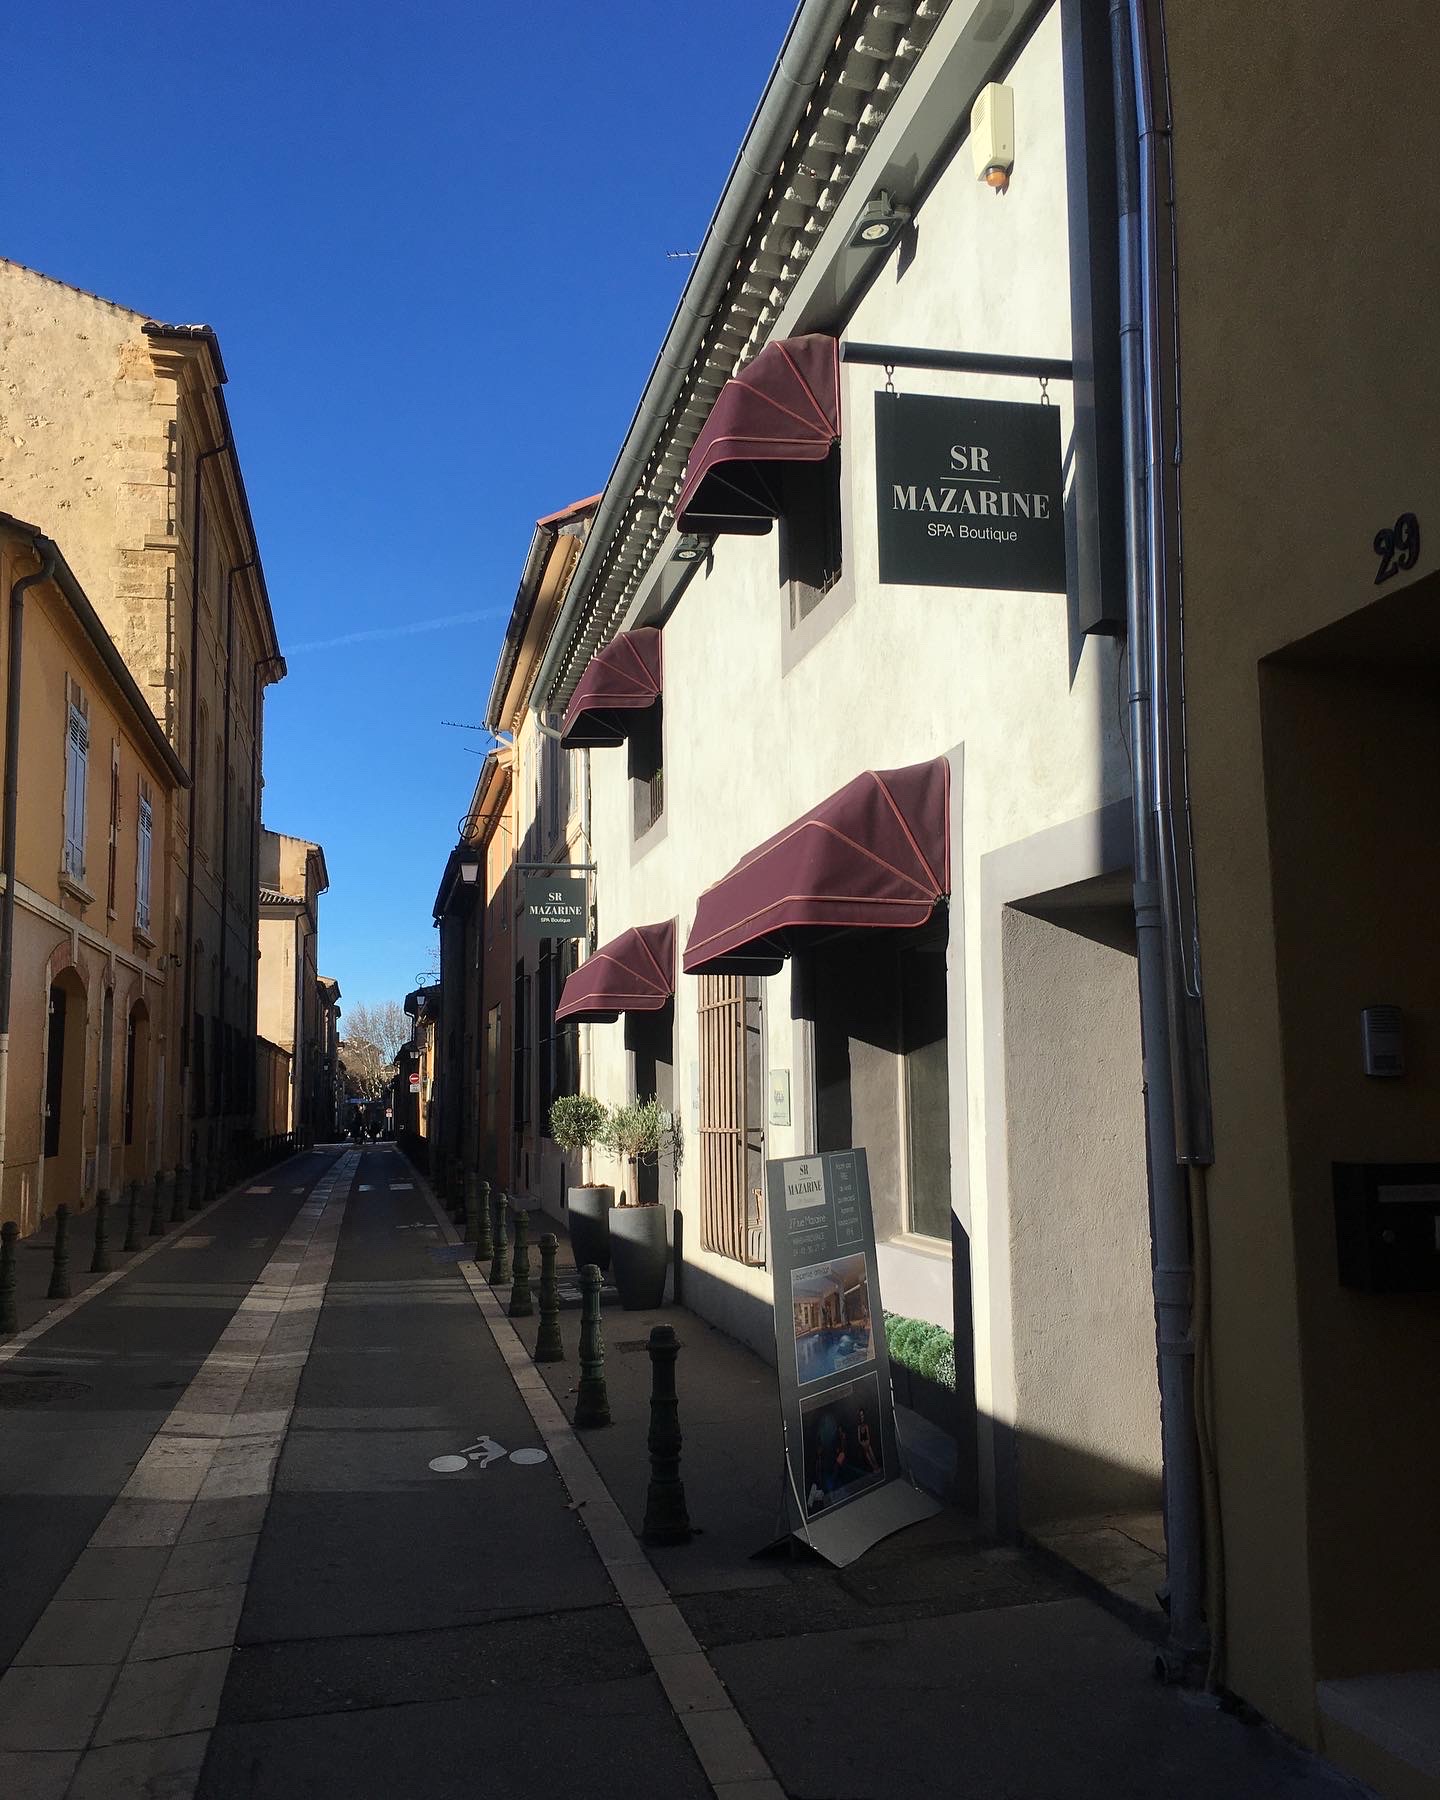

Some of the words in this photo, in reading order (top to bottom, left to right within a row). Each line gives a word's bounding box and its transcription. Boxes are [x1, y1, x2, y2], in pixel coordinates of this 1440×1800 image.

[950, 445, 990, 472] SR
[892, 484, 1050, 519] MAZARINE
[927, 523, 955, 538] SPA
[959, 525, 1018, 543] Boutique
[1373, 511, 1420, 585] 29
[548, 892, 562, 901] SR
[529, 905, 582, 915] MAZARINE
[799, 1163, 809, 1176] SR
[787, 1180, 823, 1196] MAZARINE
